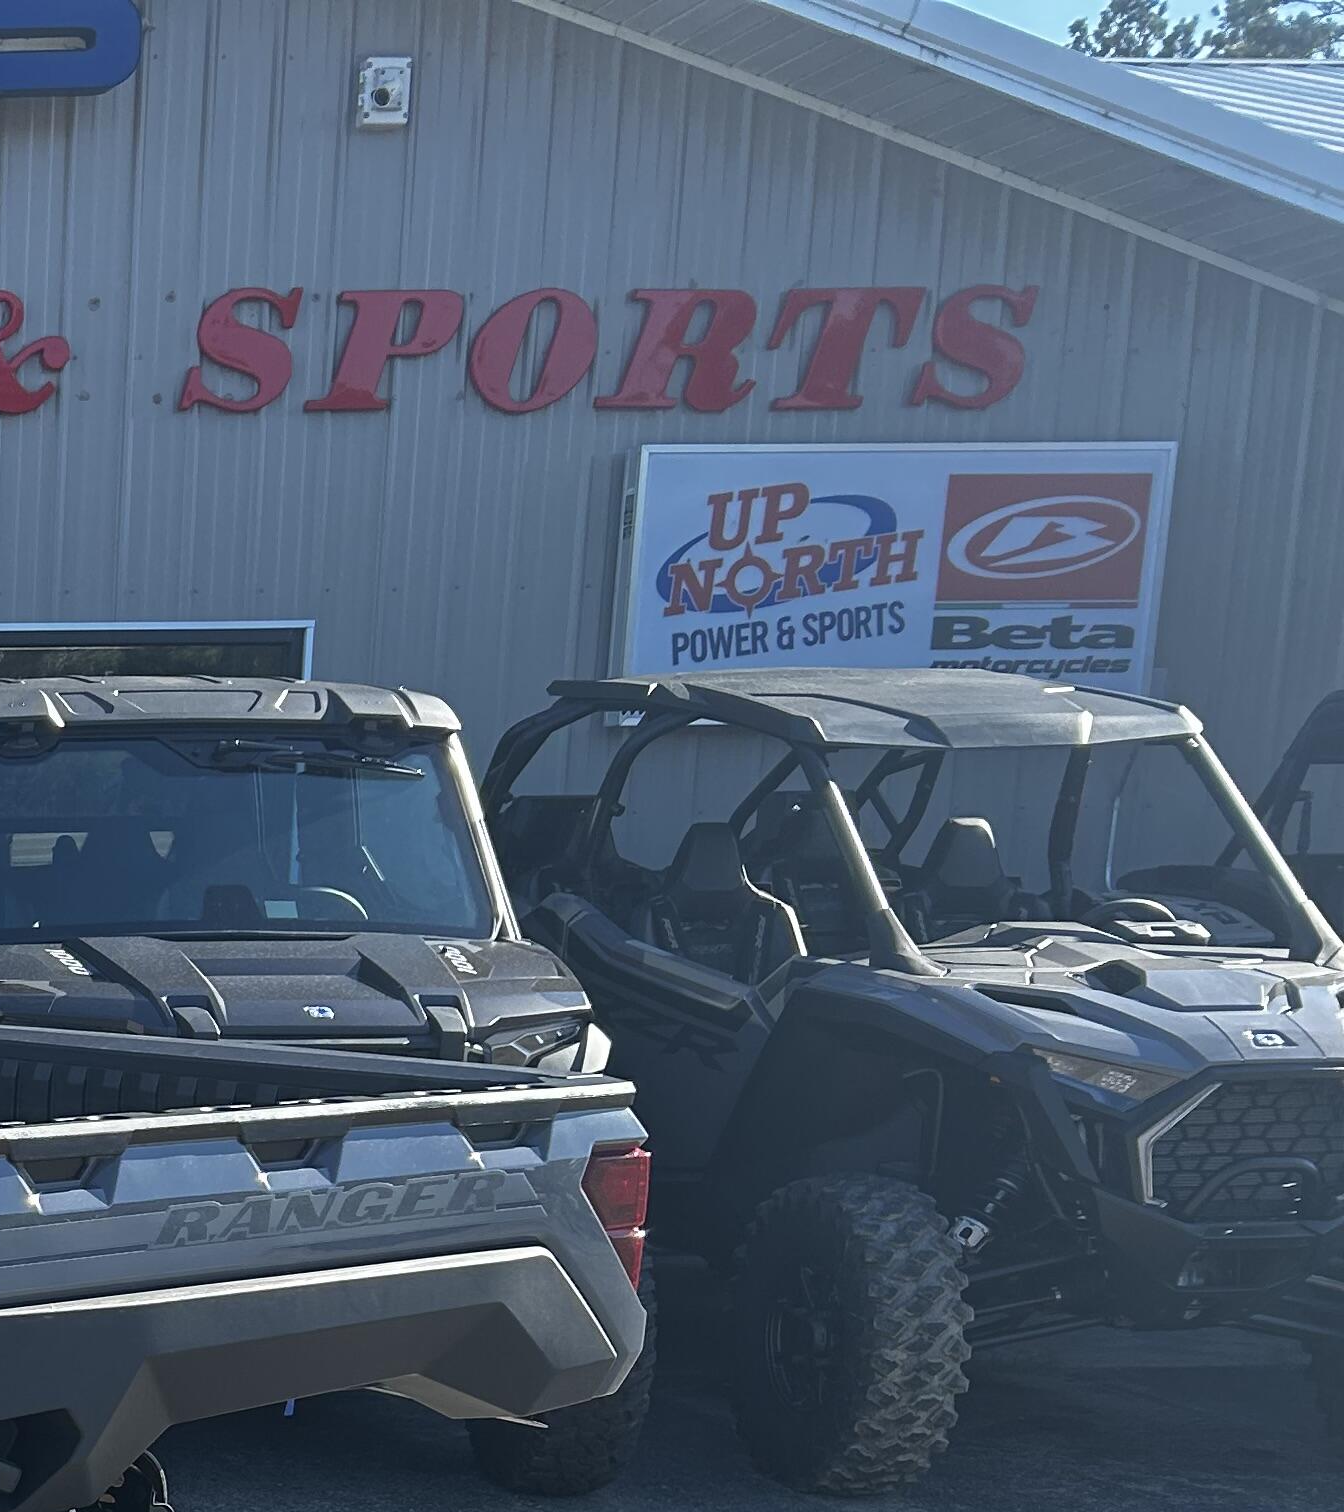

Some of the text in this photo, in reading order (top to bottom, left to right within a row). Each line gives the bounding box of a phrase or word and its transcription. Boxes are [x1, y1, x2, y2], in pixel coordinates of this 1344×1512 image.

[178, 285, 1040, 414] SPORTS
[706, 482, 811, 551] UP
[663, 529, 925, 619] NORTH
[671, 600, 906, 666] POWER & SPORTS
[930, 614, 1135, 651] Beta
[154, 1168, 507, 1247] RANGER
